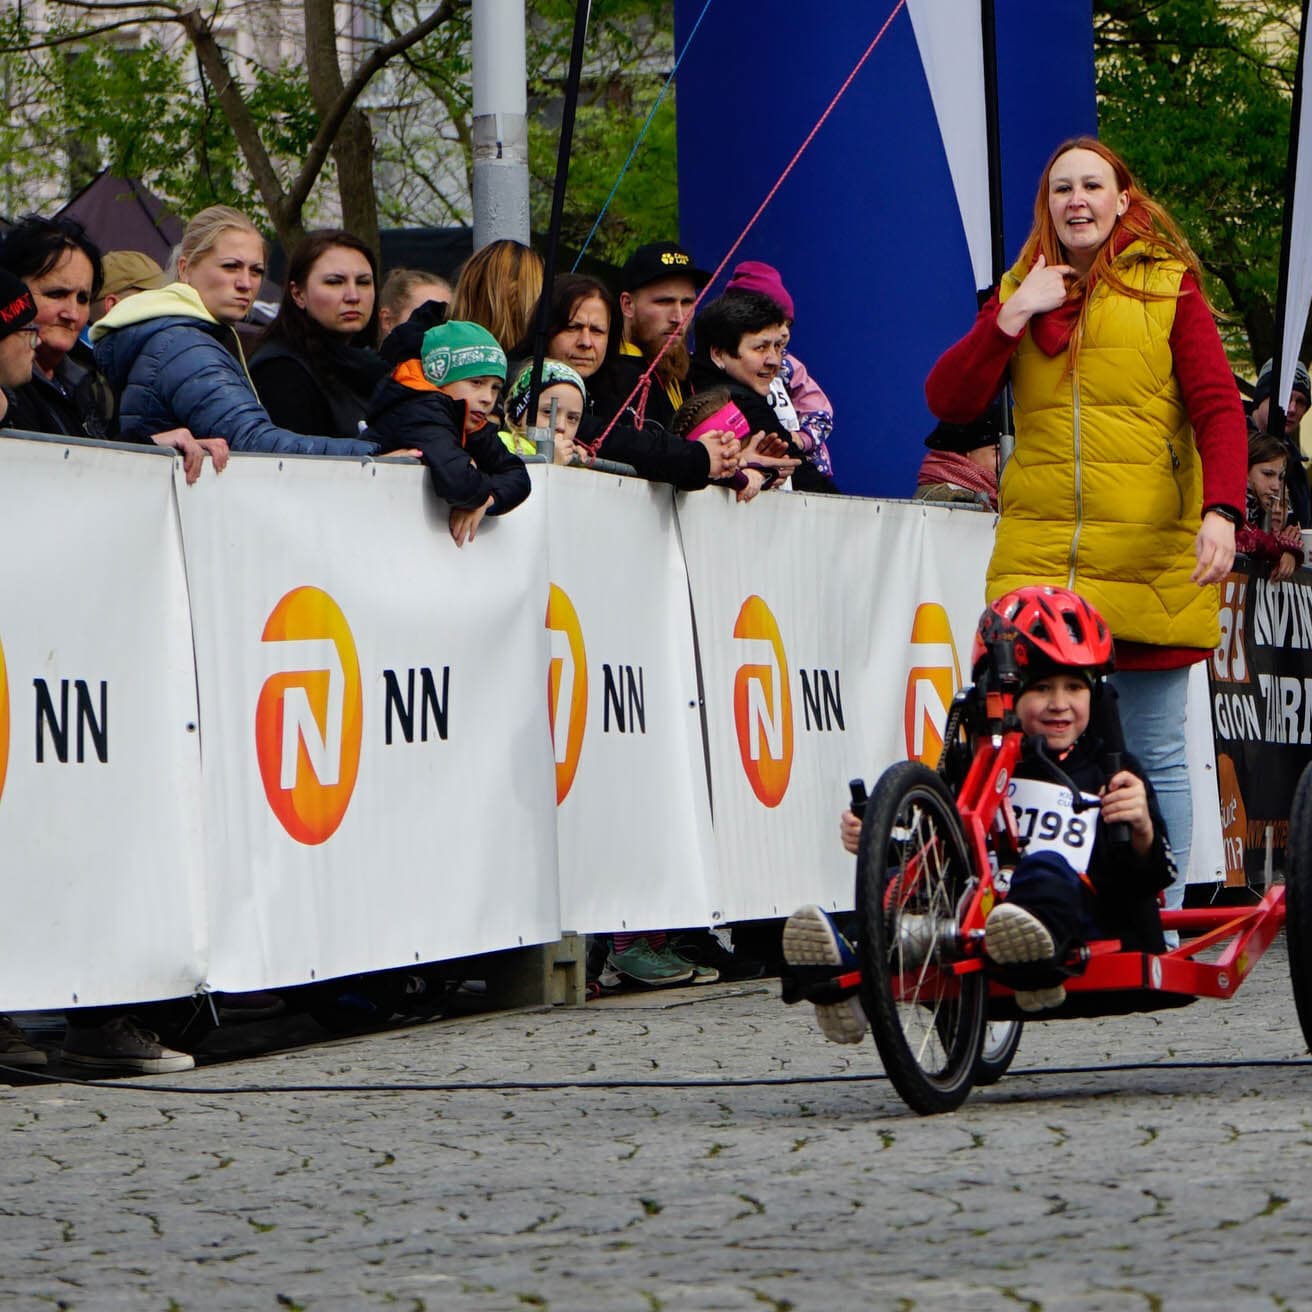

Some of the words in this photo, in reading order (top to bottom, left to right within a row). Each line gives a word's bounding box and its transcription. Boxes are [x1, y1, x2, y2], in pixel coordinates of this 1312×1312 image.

[35, 678, 109, 764] NN
[383, 666, 450, 745] NN
[602, 663, 646, 734] NN
[800, 668, 845, 731] NN
[1214, 692, 1262, 741] GION
